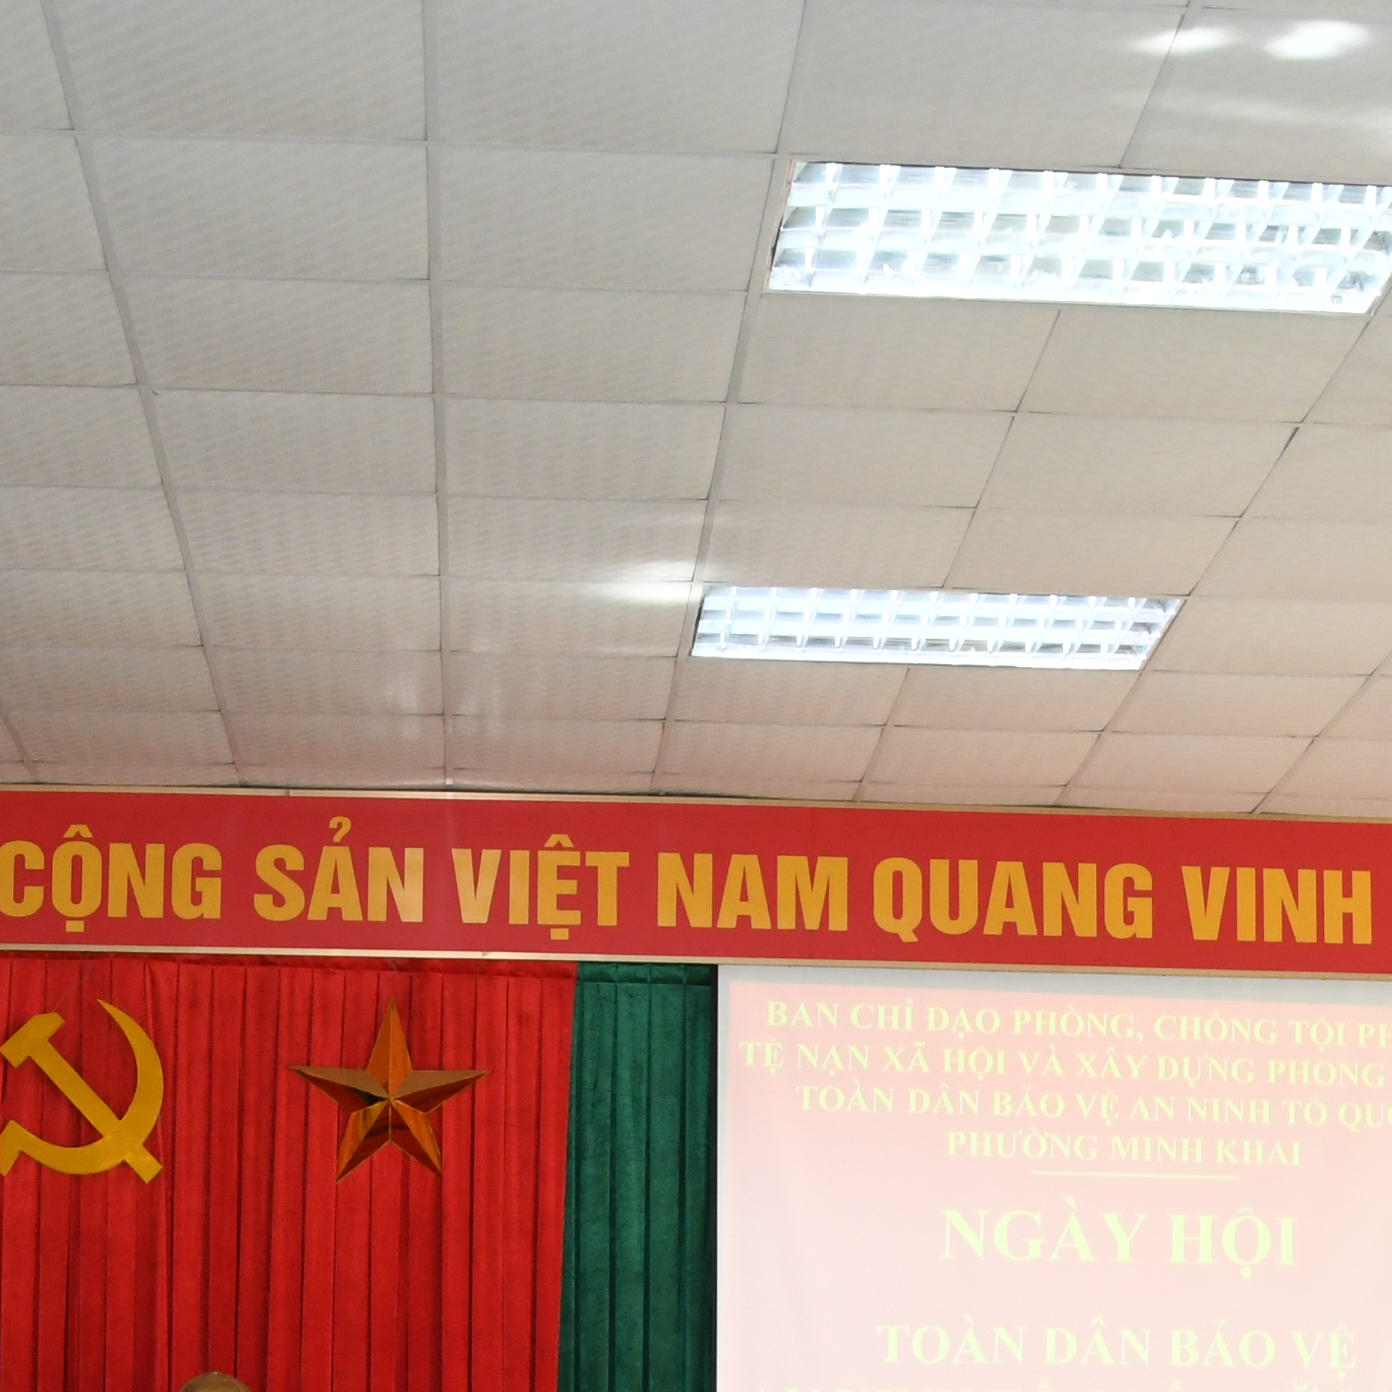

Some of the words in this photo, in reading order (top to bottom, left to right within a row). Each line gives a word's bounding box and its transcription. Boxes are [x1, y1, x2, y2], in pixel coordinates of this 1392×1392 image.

[254, 816, 424, 922] SẢN
[452, 834, 629, 940] VIỆT
[657, 853, 848, 931] NAM
[874, 857, 1152, 942] QUANG
[1182, 866, 1372, 944] VINH
[767, 1001, 839, 1029] BAN
[928, 1006, 1001, 1038] ĐẠO
[1014, 1003, 1144, 1042] PHÒNG,
[1289, 1015, 1347, 1051] TỘI
[740, 1038, 784, 1072] TỆ
[797, 1043, 869, 1076] NẠN
[882, 1043, 931, 1075] XÃ
[943, 1047, 1005, 1081] HỘI
[1018, 1045, 1064, 1078] VÀ
[1075, 1047, 1144, 1081] XÂY
[1157, 1055, 1256, 1087] DỰNG
[1271, 1059, 1386, 1089] PHONG
[795, 1080, 894, 1113] TOÀN
[907, 1084, 981, 1117] DÂN
[993, 1084, 1065, 1119] BẢO
[1075, 1087, 1121, 1124] VỆ
[1131, 1095, 1175, 1121] AN
[1186, 1097, 1271, 1125] NINH
[947, 1126, 1097, 1159] PHƯỜNG
[1110, 1134, 1204, 1164] MINH
[1216, 1137, 1302, 1167] KHAI
[941, 1194, 1149, 1263] NGÀY
[1168, 1207, 1299, 1280] HỘI
[877, 1314, 1027, 1365] TOÀN
[1043, 1315, 1152, 1367] DÂN
[1169, 1317, 1276, 1369] BẢO
[1289, 1324, 1358, 1380] VỆ
